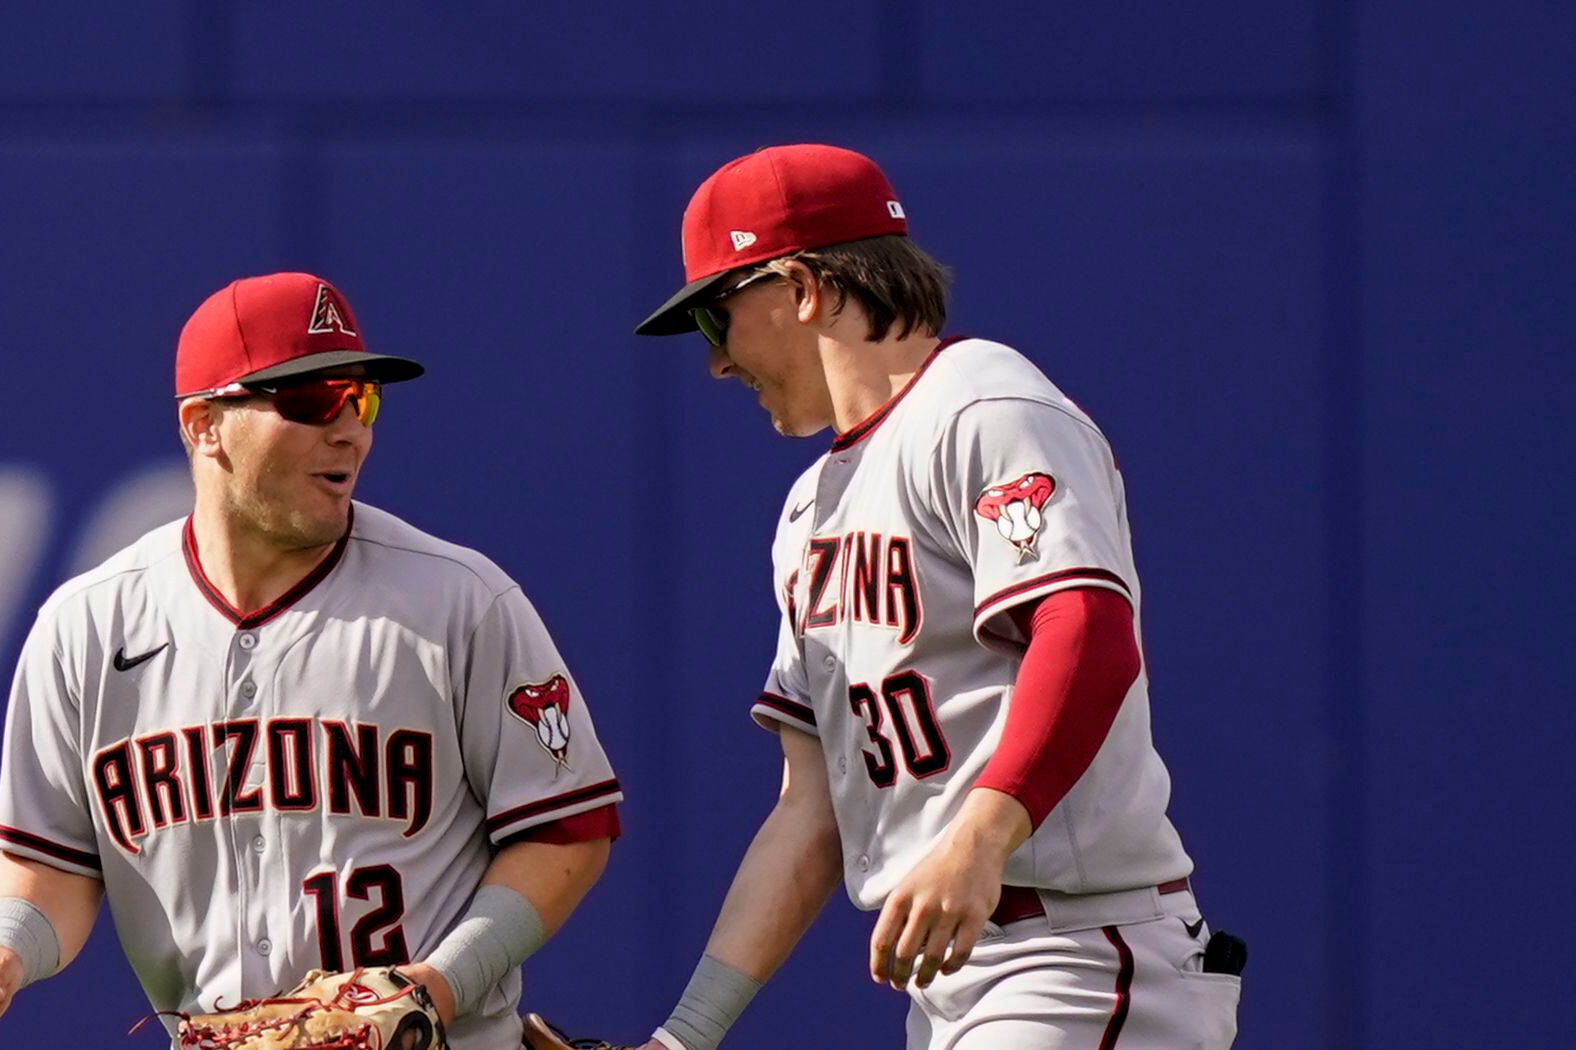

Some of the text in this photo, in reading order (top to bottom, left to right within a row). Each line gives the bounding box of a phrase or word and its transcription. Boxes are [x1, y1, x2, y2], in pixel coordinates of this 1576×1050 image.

[91, 715, 433, 855] ARIZONA
[848, 669, 952, 789] 30
[302, 863, 411, 974] 12
